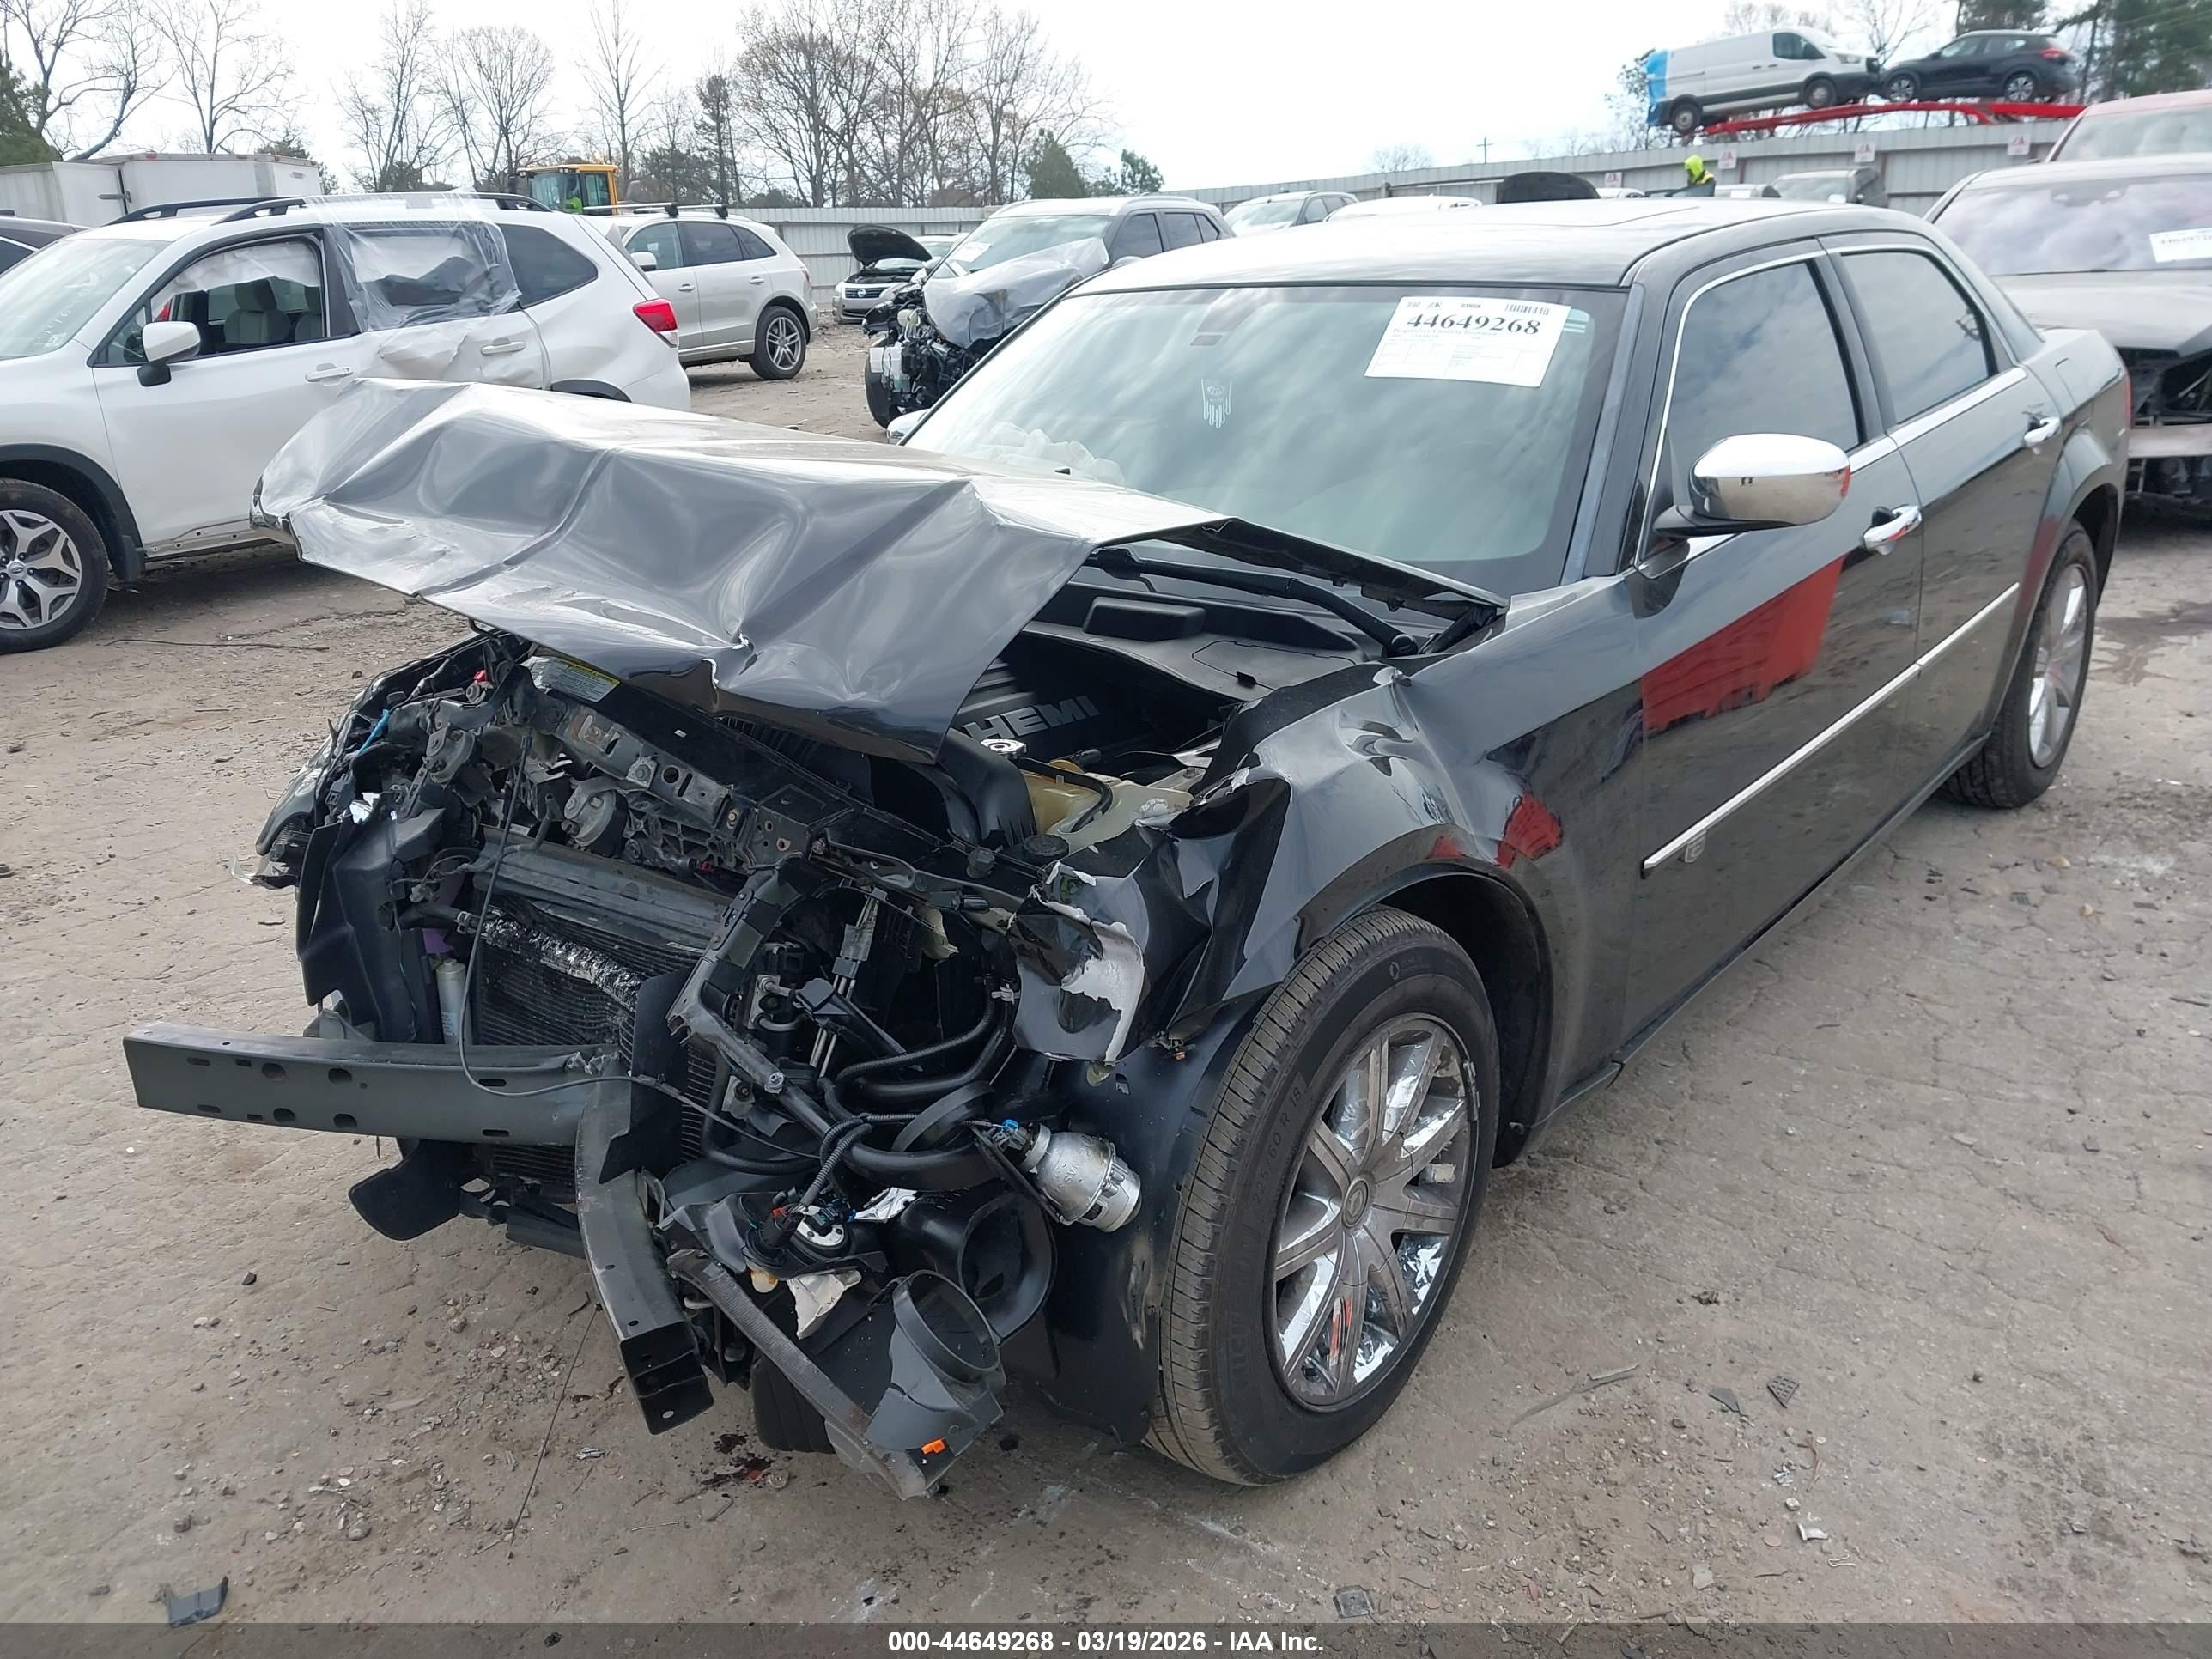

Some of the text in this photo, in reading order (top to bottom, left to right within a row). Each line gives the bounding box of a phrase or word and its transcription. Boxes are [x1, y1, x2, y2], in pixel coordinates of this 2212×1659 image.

[1407, 313, 1541, 335] 44649268
[963, 696, 1100, 739] HEMI
[1279, 1112, 1290, 1127] R
